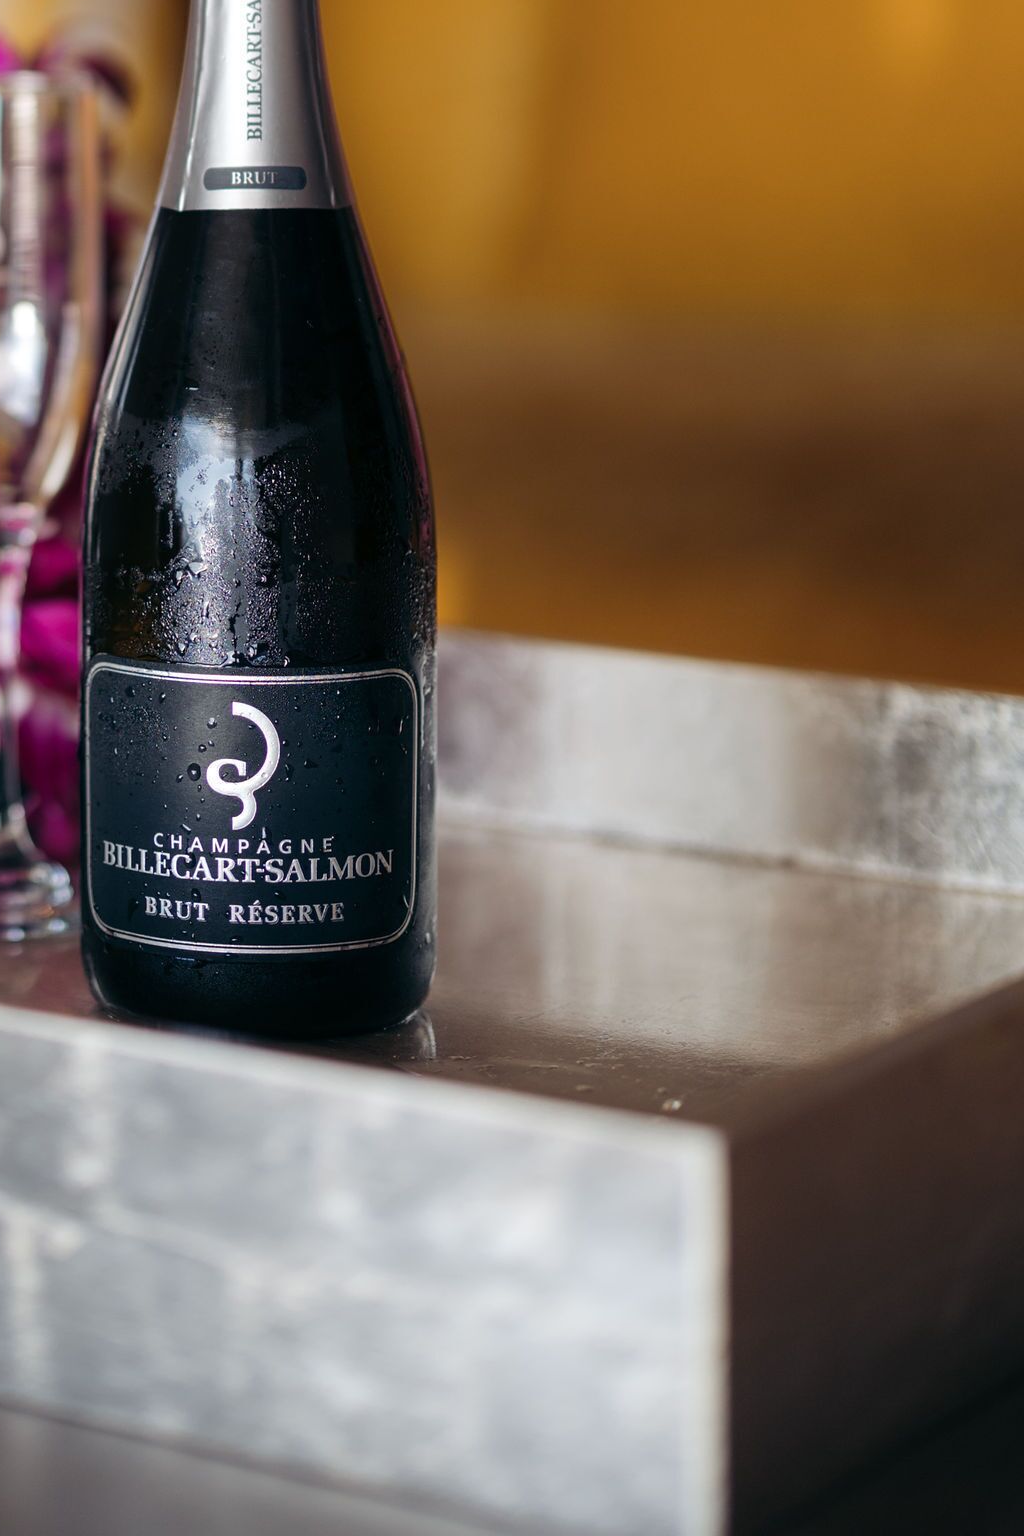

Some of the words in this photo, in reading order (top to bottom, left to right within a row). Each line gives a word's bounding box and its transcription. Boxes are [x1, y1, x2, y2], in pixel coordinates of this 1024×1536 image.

[231, 171, 278, 185] BRUT
[153, 831, 334, 854] CHAMPAGNE
[103, 840, 394, 883] BILLECART-SALMON
[145, 896, 208, 923] BRUT
[229, 899, 345, 924] RÉSERVE
